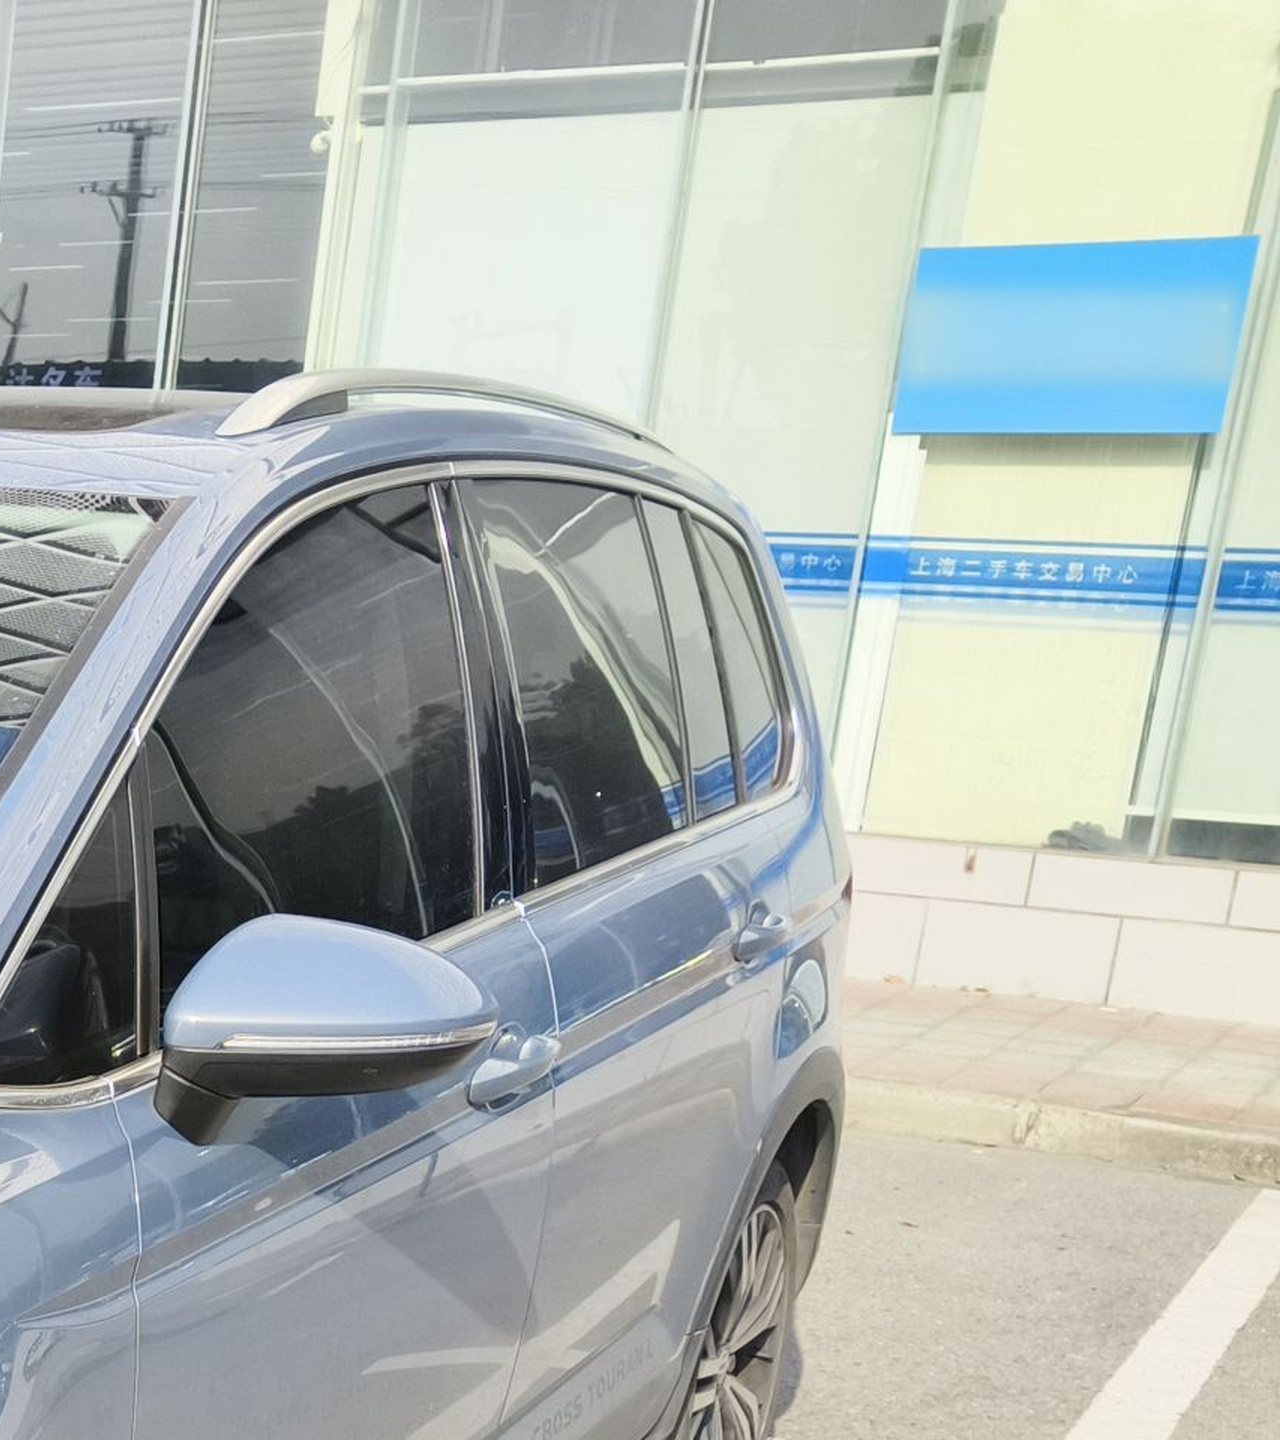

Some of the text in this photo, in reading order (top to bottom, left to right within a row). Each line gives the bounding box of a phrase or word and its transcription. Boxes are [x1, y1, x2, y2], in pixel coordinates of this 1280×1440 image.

[908, 556, 1141, 585] 上海二手车交易中心
